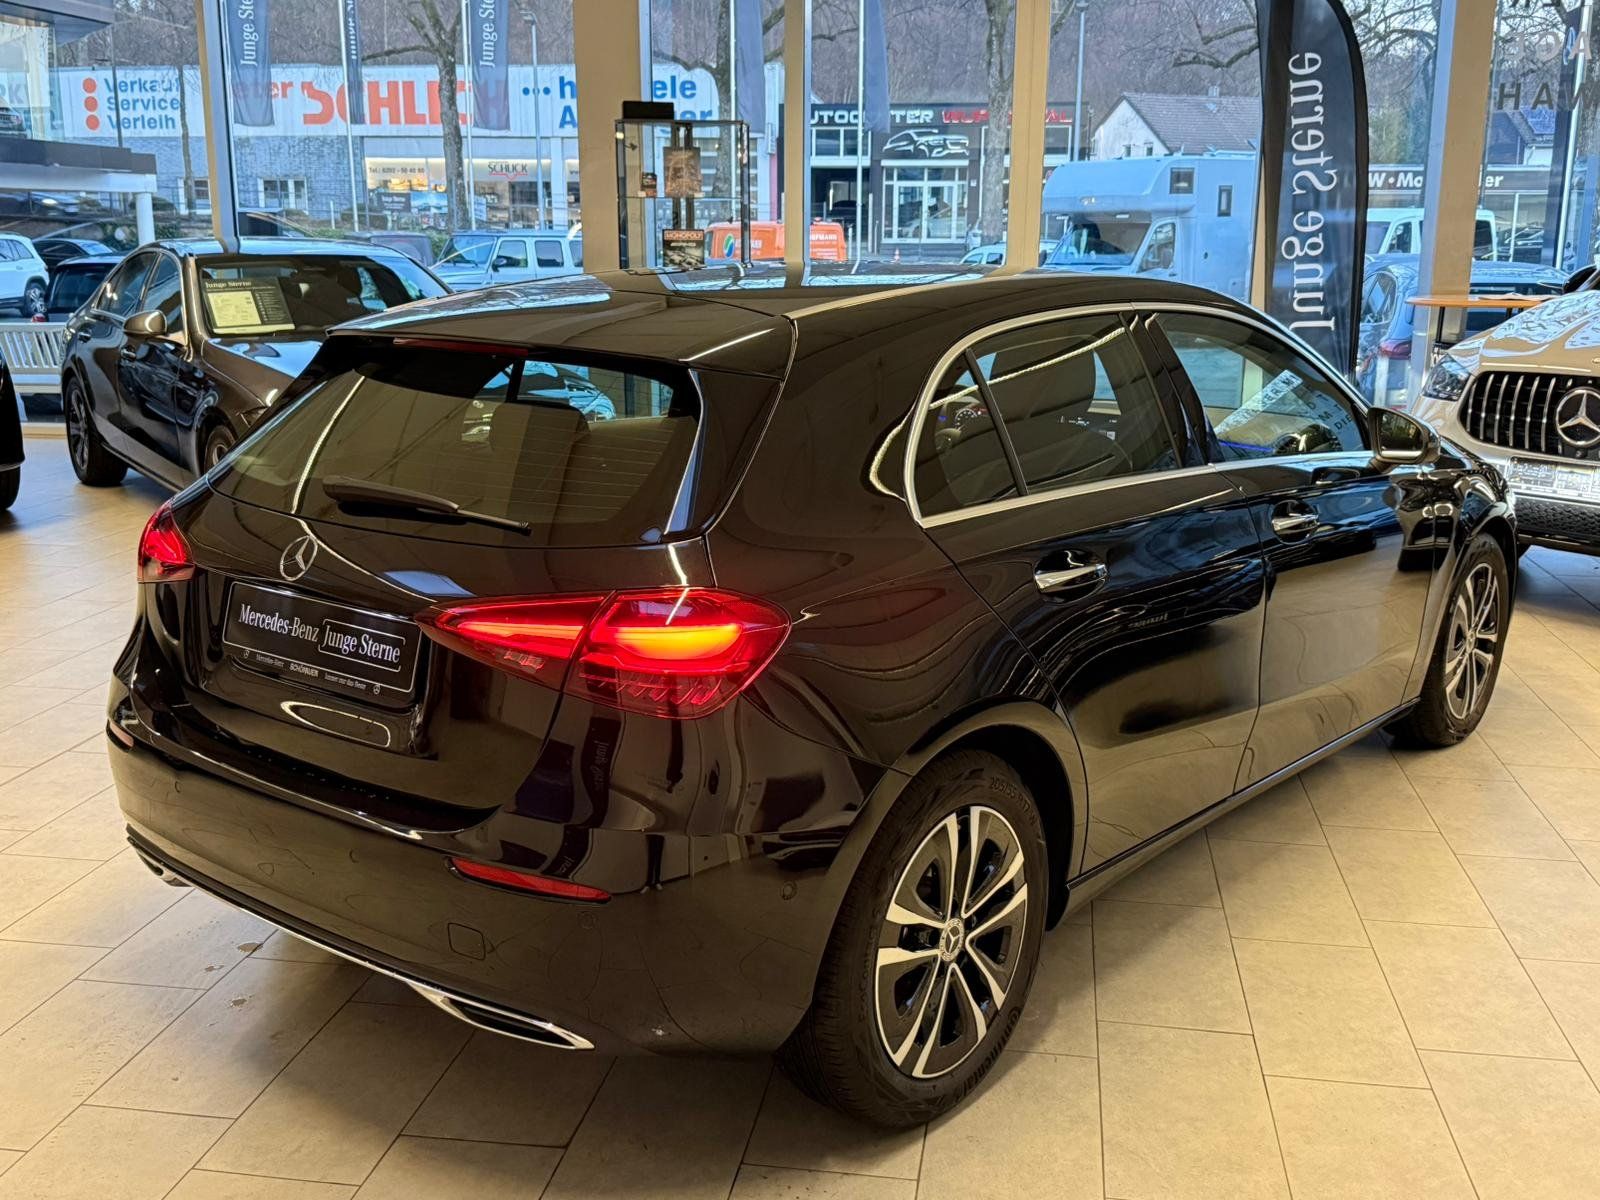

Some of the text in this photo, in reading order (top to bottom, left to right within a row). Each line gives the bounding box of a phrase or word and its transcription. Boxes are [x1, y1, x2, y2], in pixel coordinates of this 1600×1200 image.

[240, 23, 259, 67] Junge
[479, 22, 498, 68] Junge
[107, 95, 180, 111] Service
[107, 114, 176, 129] Verleih
[238, 603, 401, 663] Mercedes-Benz Junge Sterne
